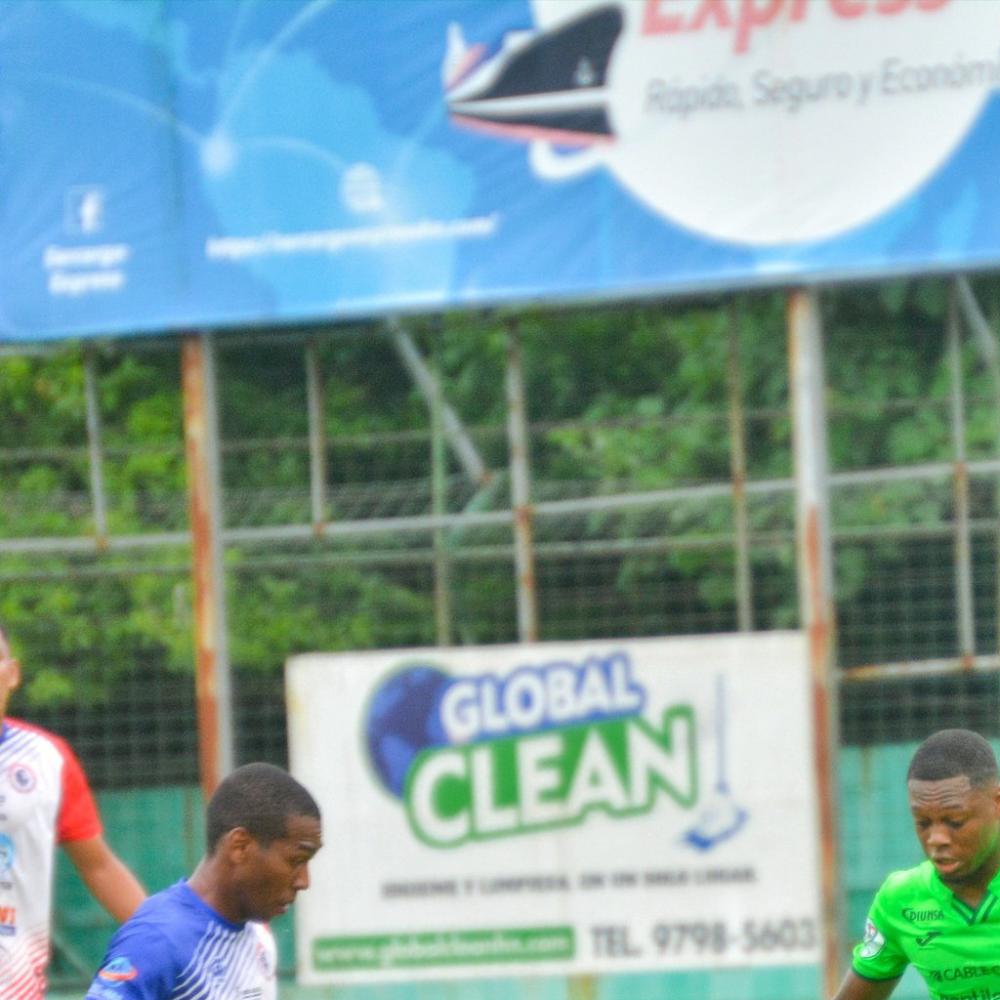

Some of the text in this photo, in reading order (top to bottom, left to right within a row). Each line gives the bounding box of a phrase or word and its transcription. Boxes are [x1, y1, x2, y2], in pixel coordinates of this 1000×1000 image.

[750, 68, 851, 114] Seguro
[856, 72, 872, 106] y
[440, 654, 643, 739] GLOBAL
[407, 709, 695, 847] CLEAN
[591, 916, 817, 958] TEL. 9798-5603
